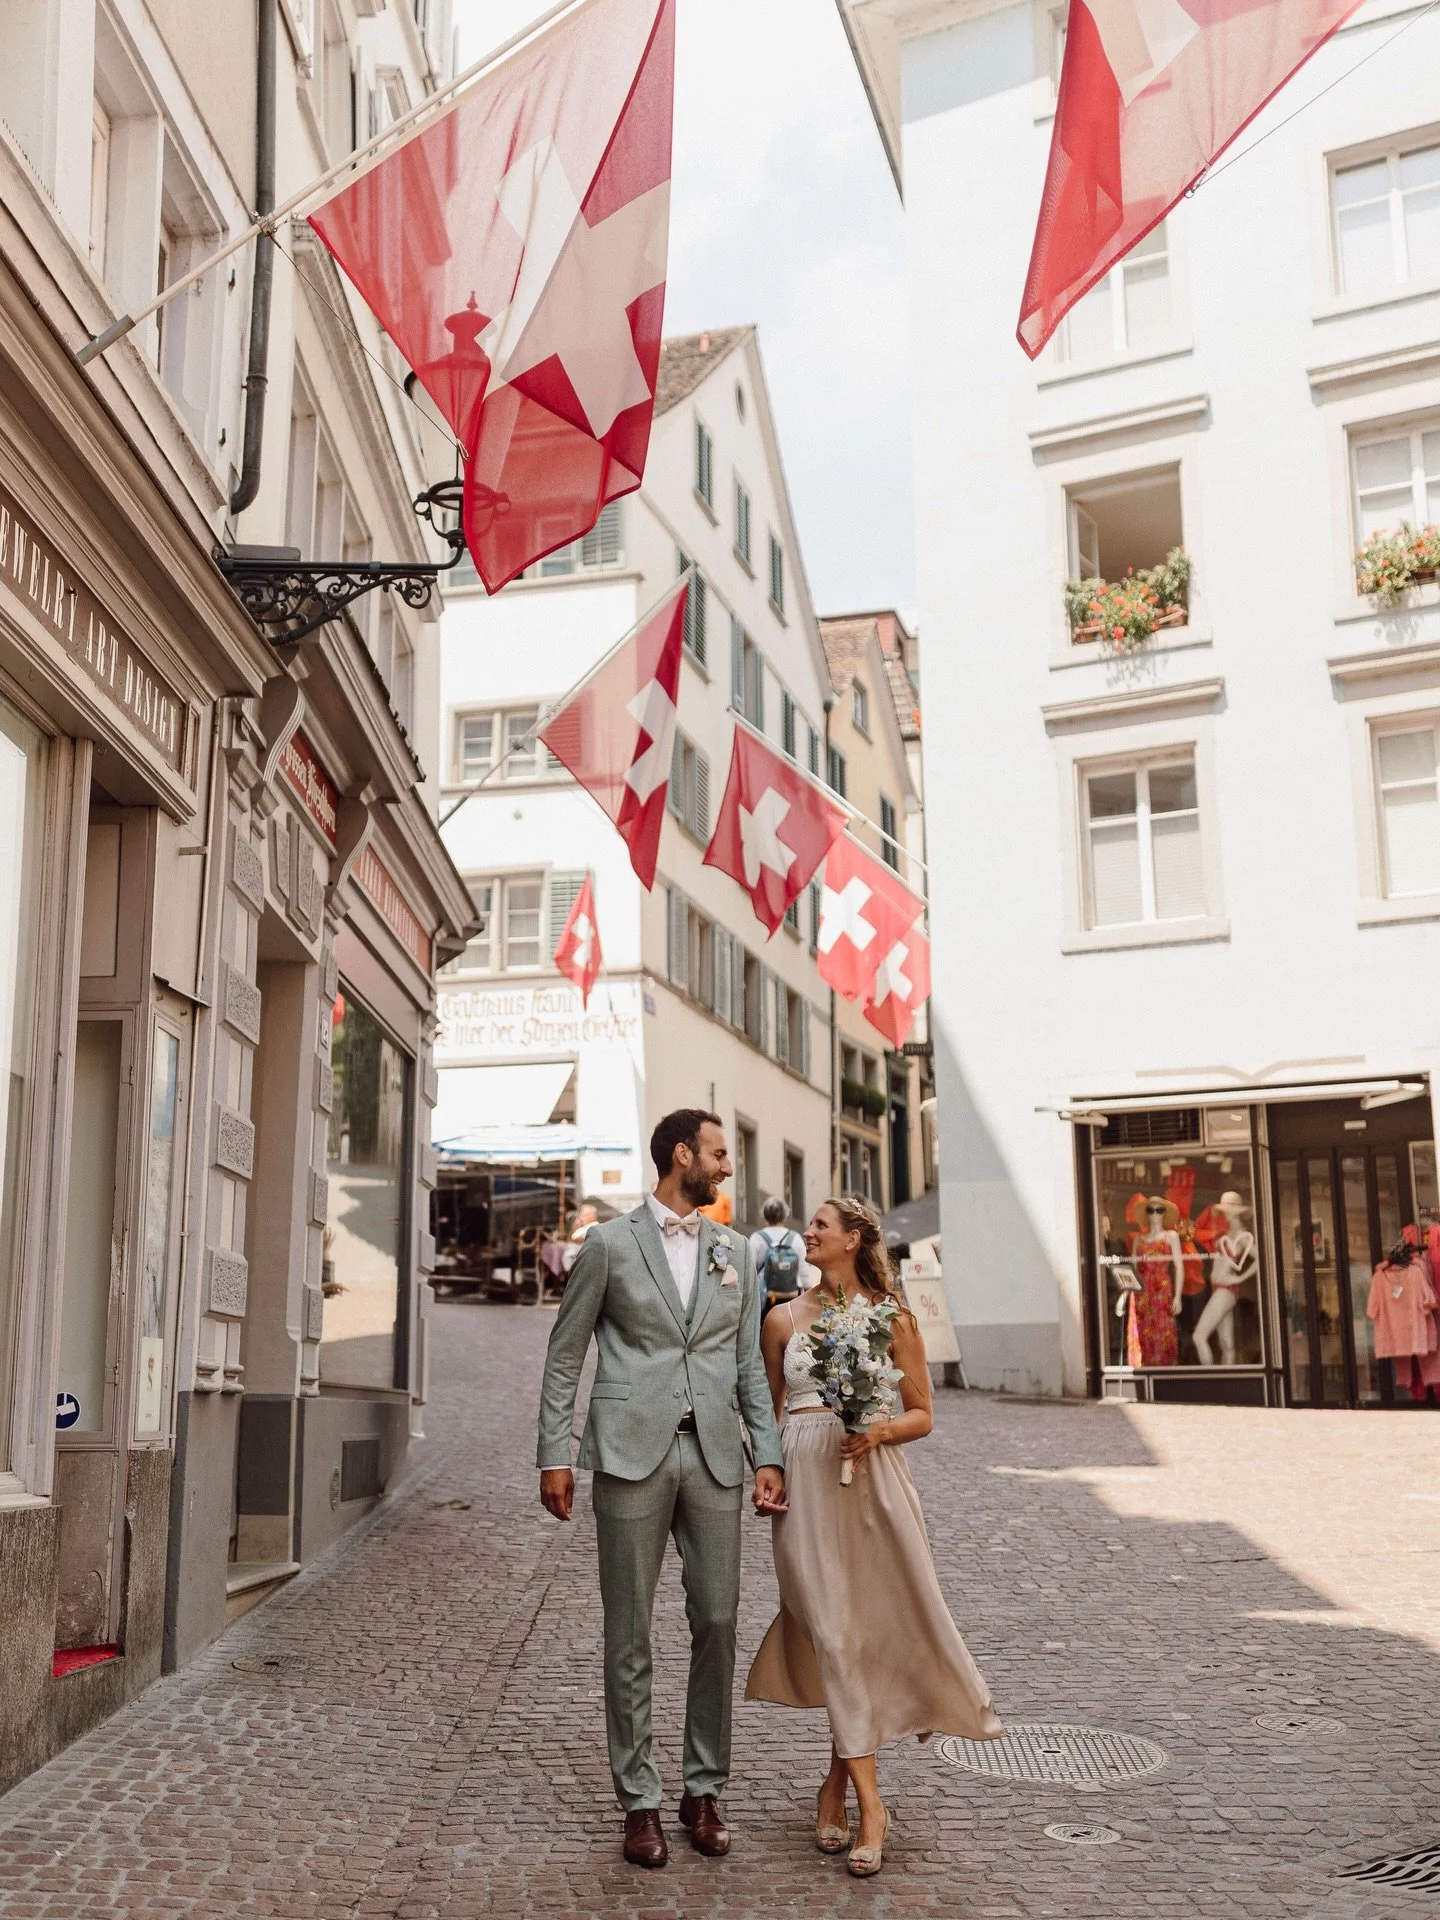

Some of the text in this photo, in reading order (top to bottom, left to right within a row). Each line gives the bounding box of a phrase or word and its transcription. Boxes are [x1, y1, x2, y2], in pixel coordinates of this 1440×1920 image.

[0, 505, 177, 753] EWELRY ART DESIGN
[920, 1294, 939, 1317] %
